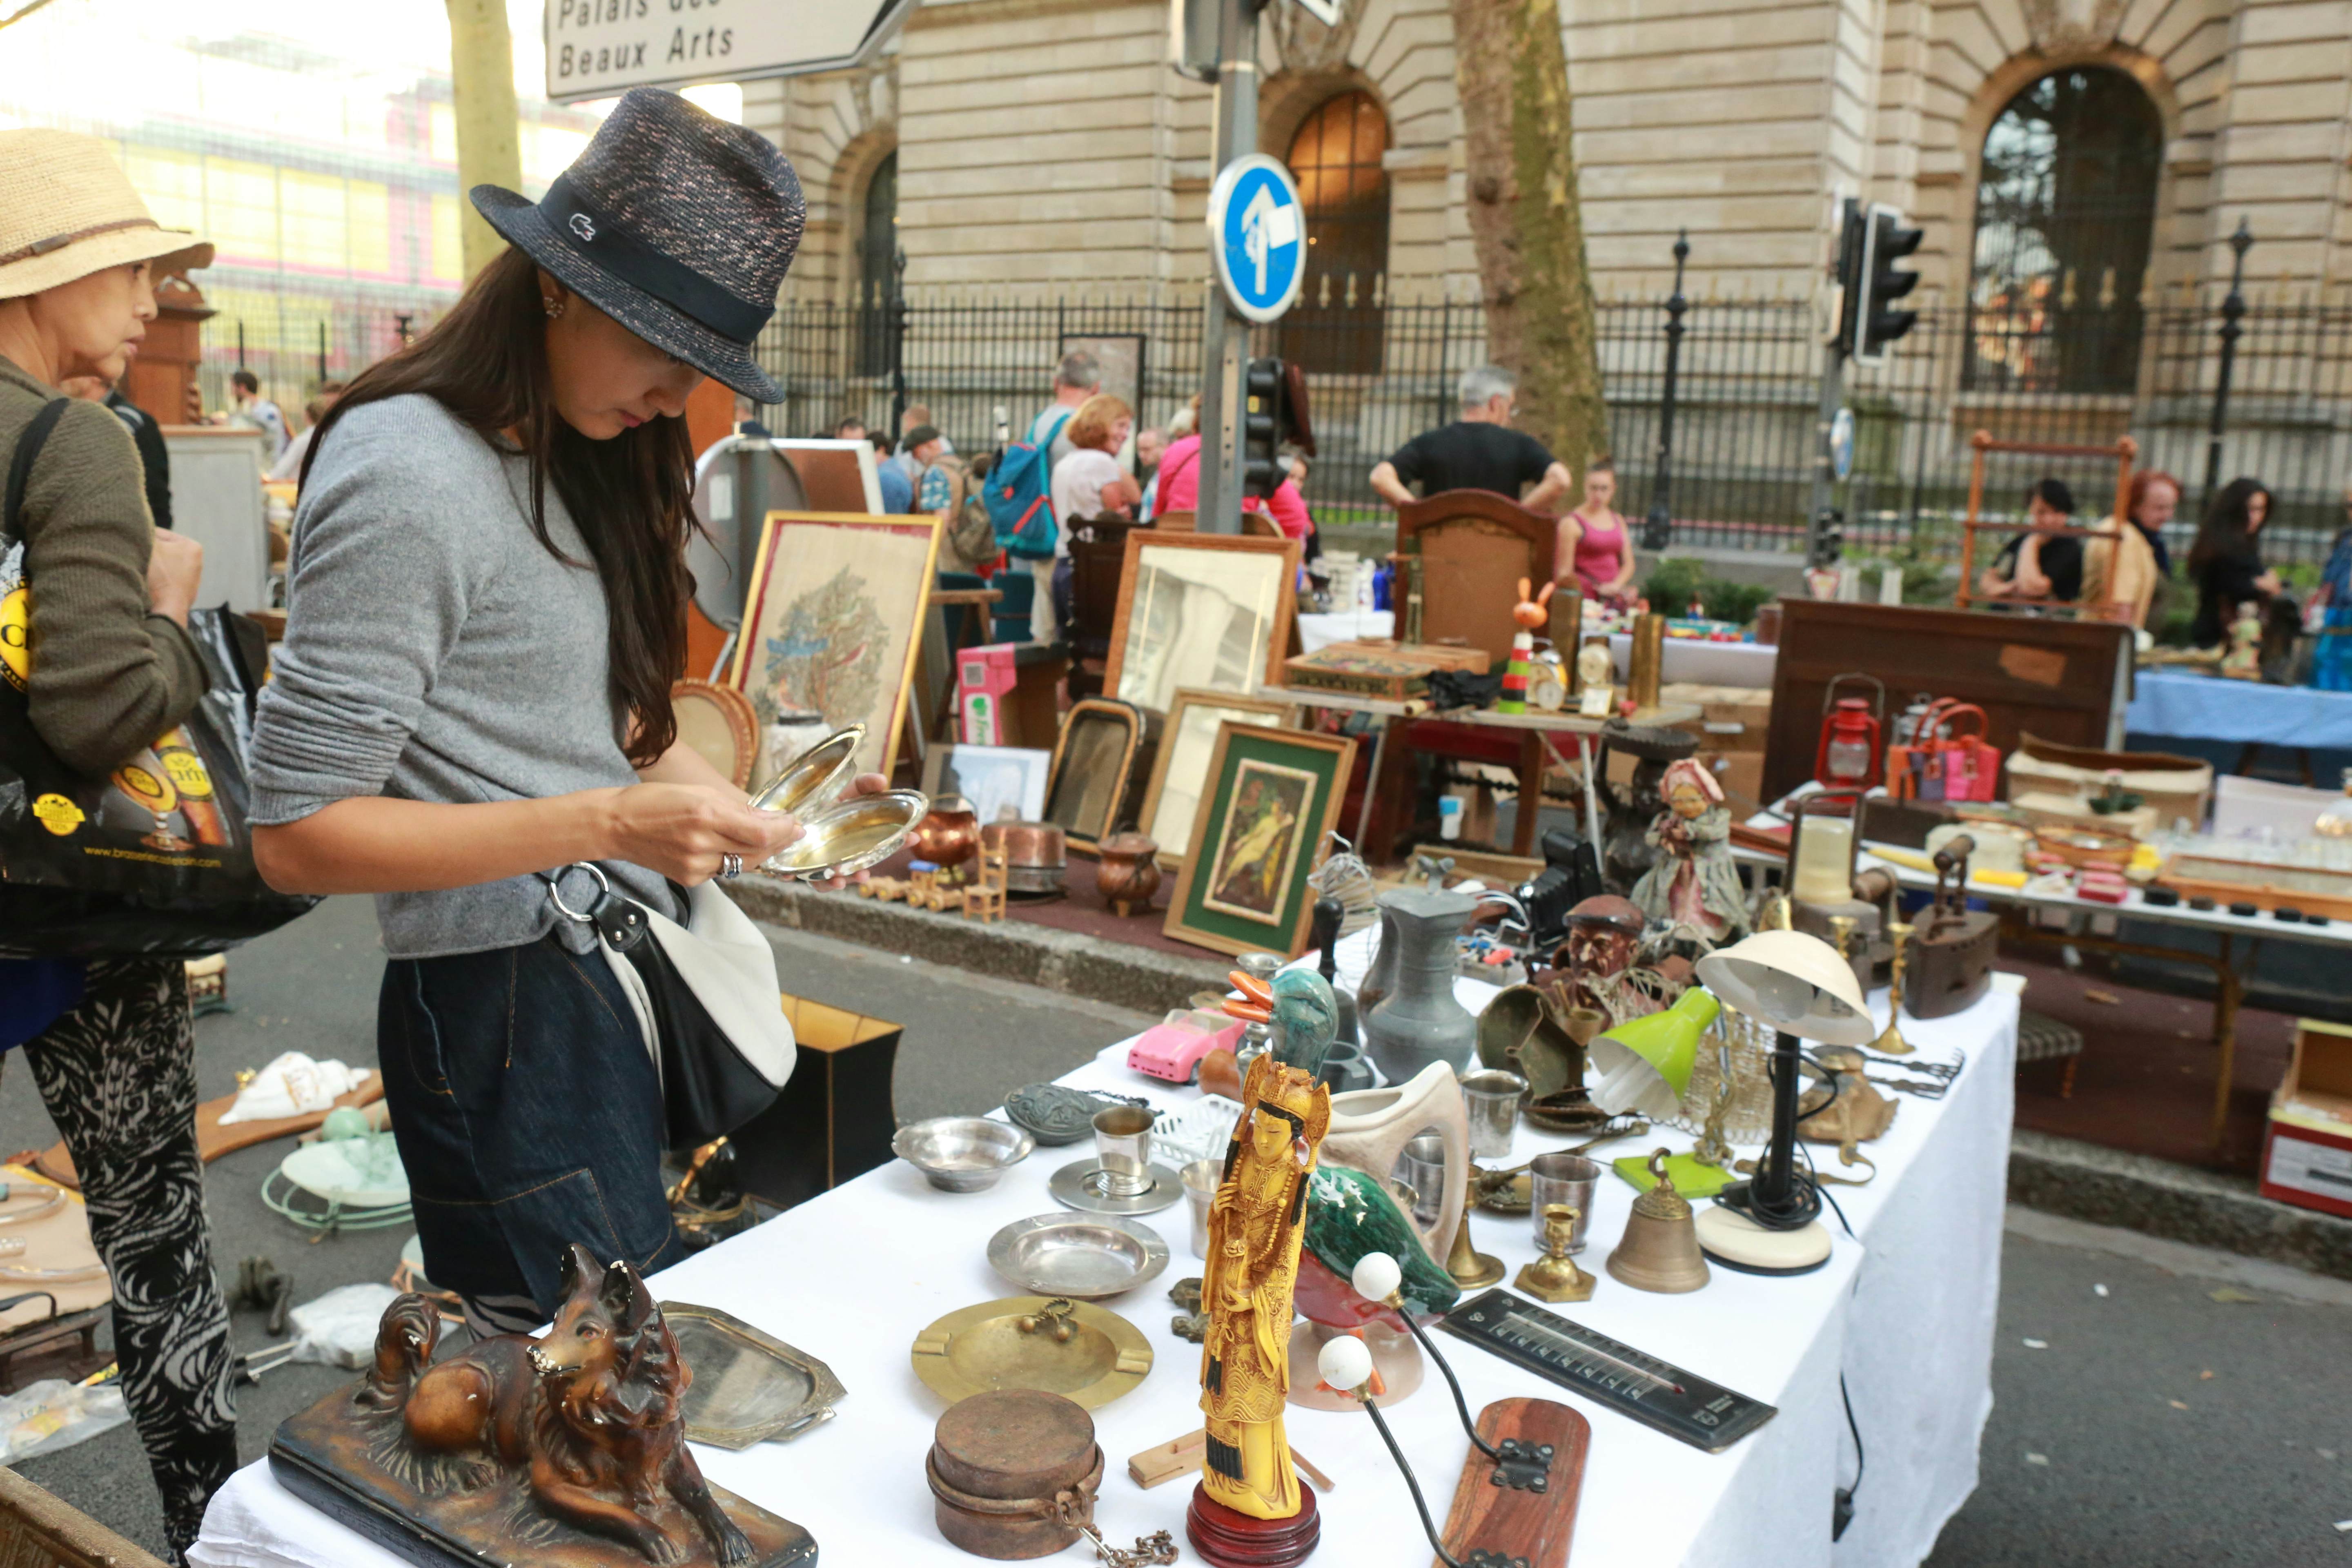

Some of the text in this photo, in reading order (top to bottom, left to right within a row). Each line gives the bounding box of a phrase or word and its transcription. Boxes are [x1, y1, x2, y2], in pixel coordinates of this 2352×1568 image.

[558, 0, 649, 29] Palais
[559, 26, 734, 78] Beaux Arts
